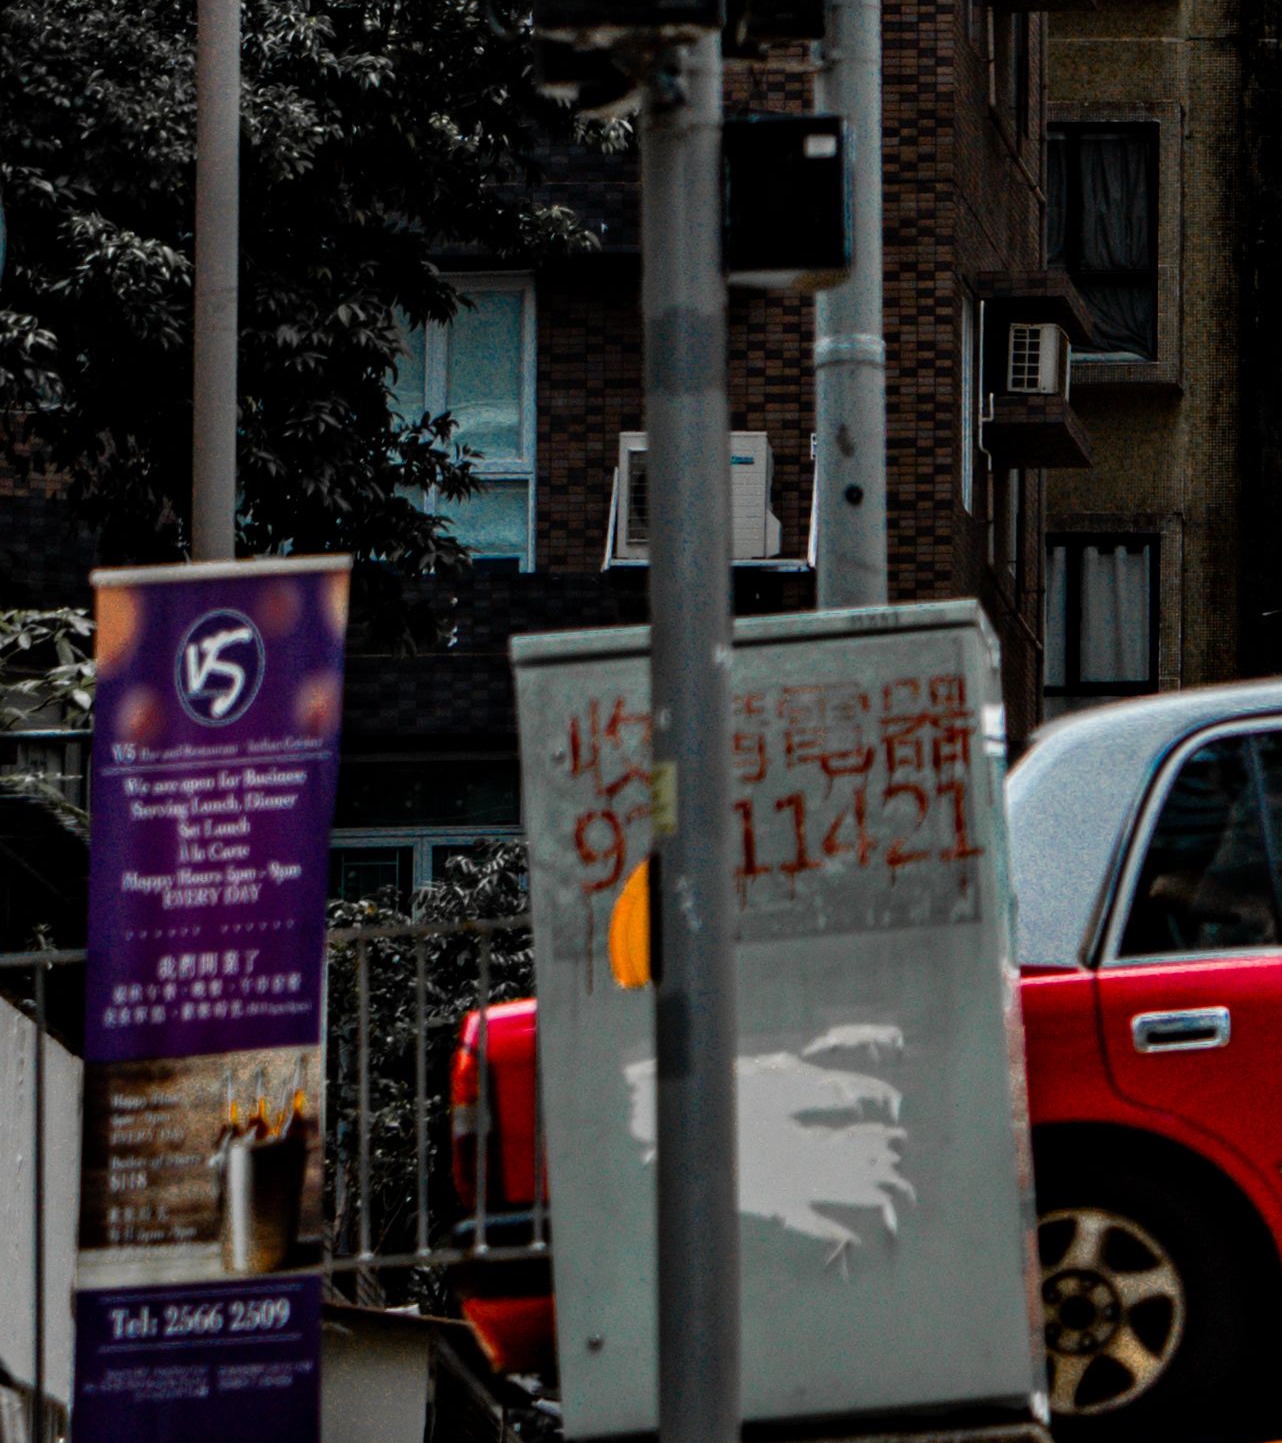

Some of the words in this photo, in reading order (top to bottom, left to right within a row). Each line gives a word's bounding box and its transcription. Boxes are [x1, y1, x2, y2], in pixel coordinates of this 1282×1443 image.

[124, 777, 149, 795] We
[154, 778, 179, 792] are
[180, 775, 215, 795] open
[218, 769, 241, 787] for
[243, 767, 308, 786] Business
[131, 799, 189, 820] Serving
[244, 792, 299, 811] Dinner
[177, 820, 201, 839] Set
[204, 816, 251, 835] Lunch
[207, 842, 251, 861] Carte
[121, 871, 174, 894] Happy
[176, 868, 223, 886] Hours
[267, 860, 302, 885] 9pm
[161, 886, 222, 909] EVERY
[223, 883, 263, 905] DAY
[110, 1305, 159, 1341] Tel:
[163, 1302, 225, 1336] 2566
[229, 1296, 291, 1333] 2509
